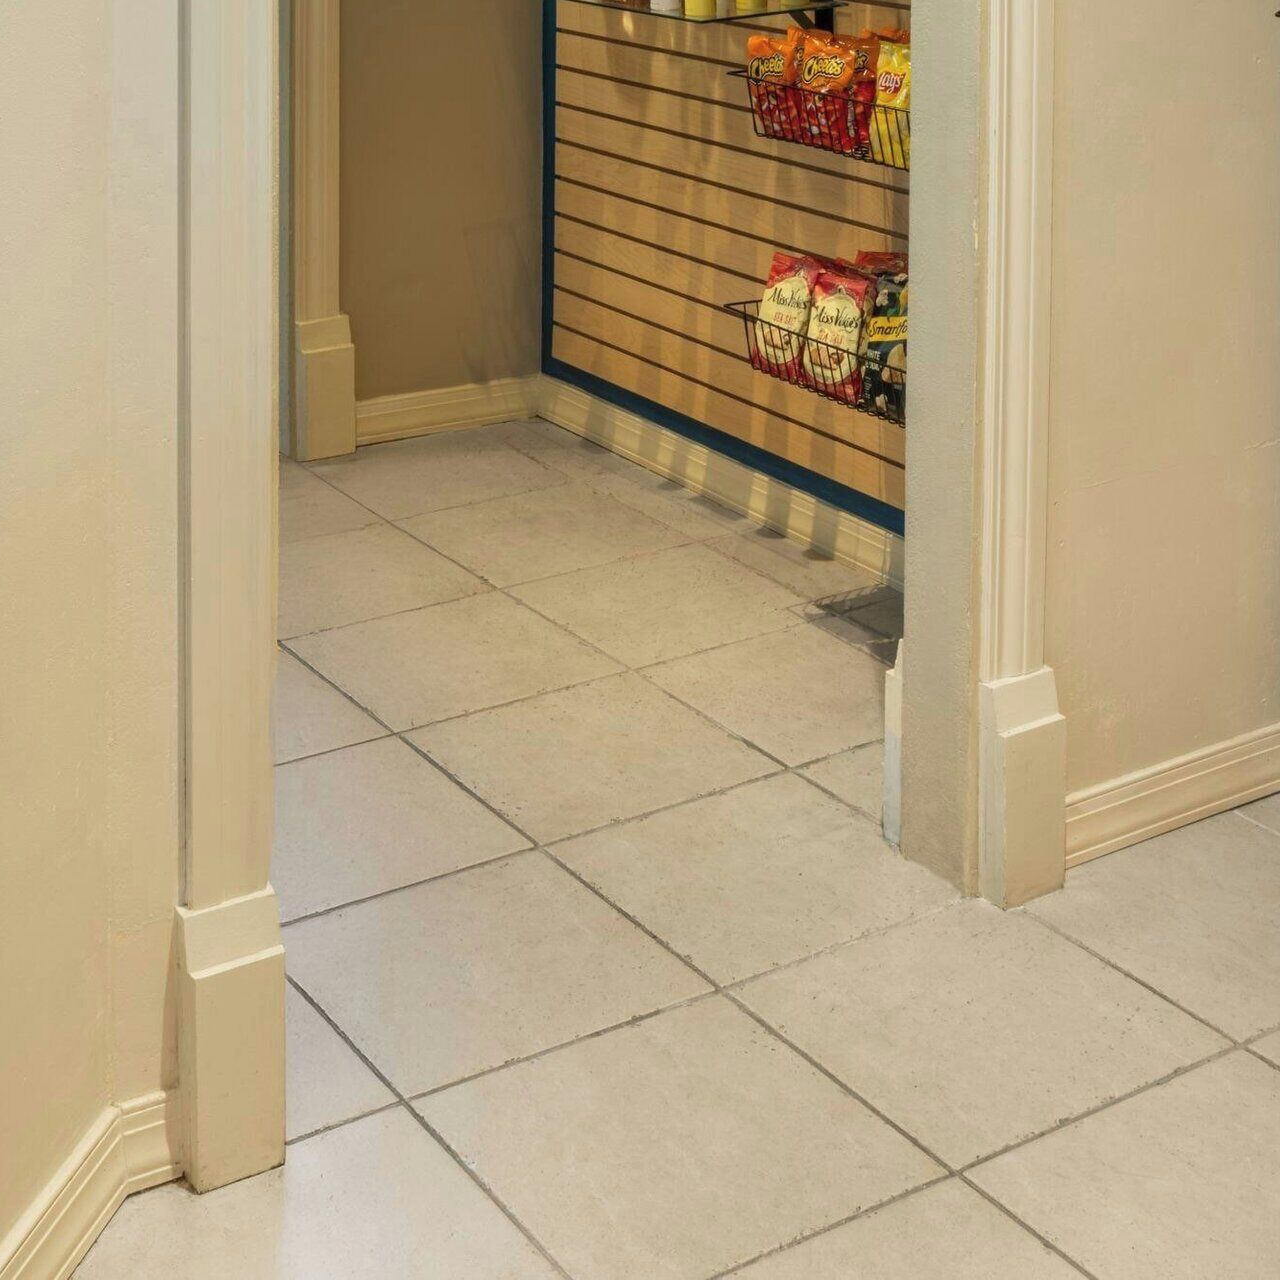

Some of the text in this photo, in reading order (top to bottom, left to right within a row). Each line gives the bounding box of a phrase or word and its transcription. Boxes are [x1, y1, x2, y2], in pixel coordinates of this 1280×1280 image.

[749, 54, 785, 81] Cheetos
[803, 55, 846, 83] Cheetos
[767, 287, 788, 307] Miss
[868, 318, 908, 339] Smartfo
